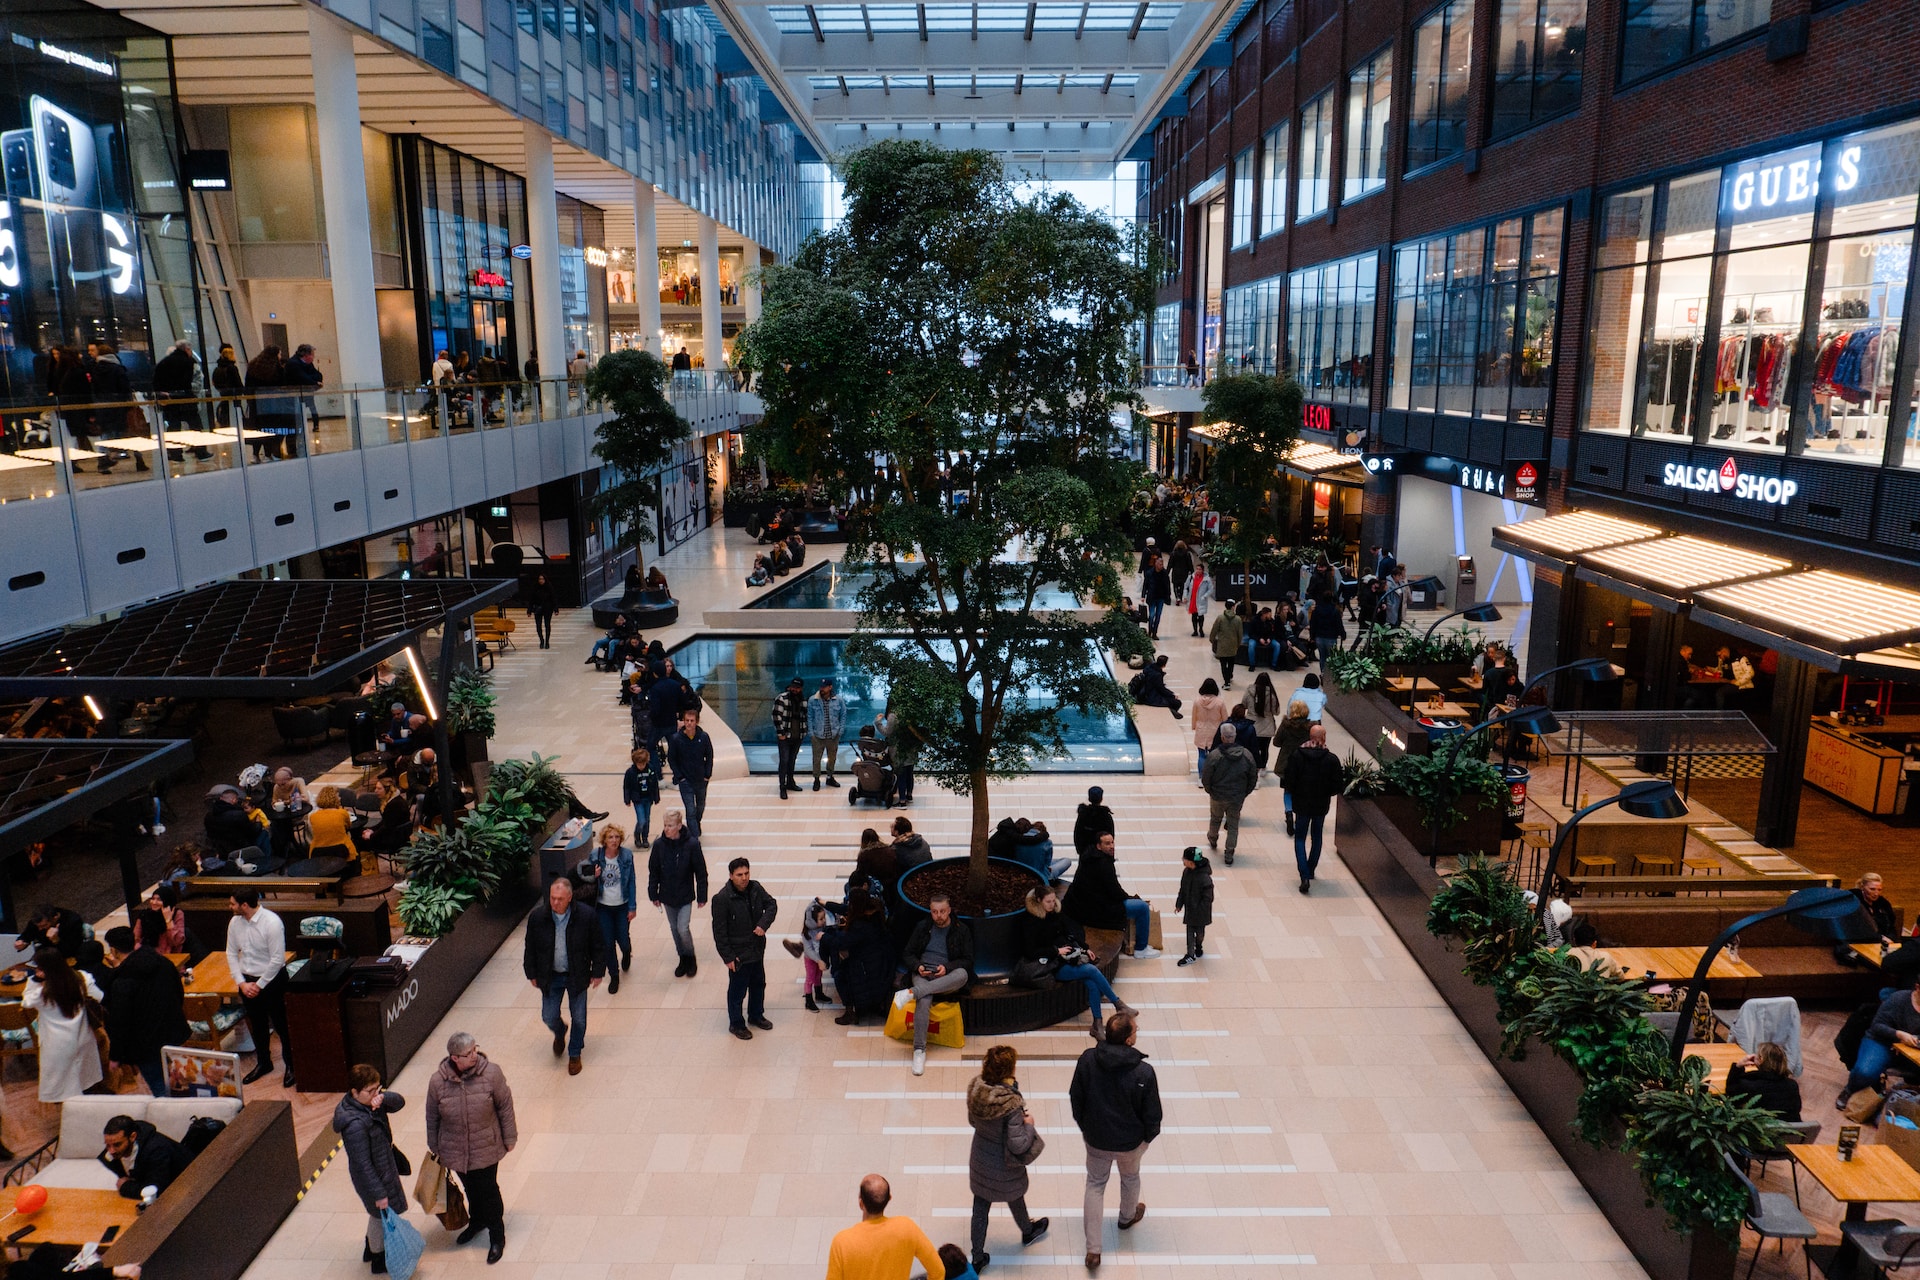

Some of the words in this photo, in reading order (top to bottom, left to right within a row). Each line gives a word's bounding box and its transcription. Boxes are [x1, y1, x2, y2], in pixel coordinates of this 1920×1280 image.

[1303, 404, 1331, 431] LEON
[1340, 447, 1364, 455] LEON
[1664, 463, 1720, 493] SALSA
[1736, 474, 1798, 505] SHOP
[387, 979, 419, 1029] MADO
